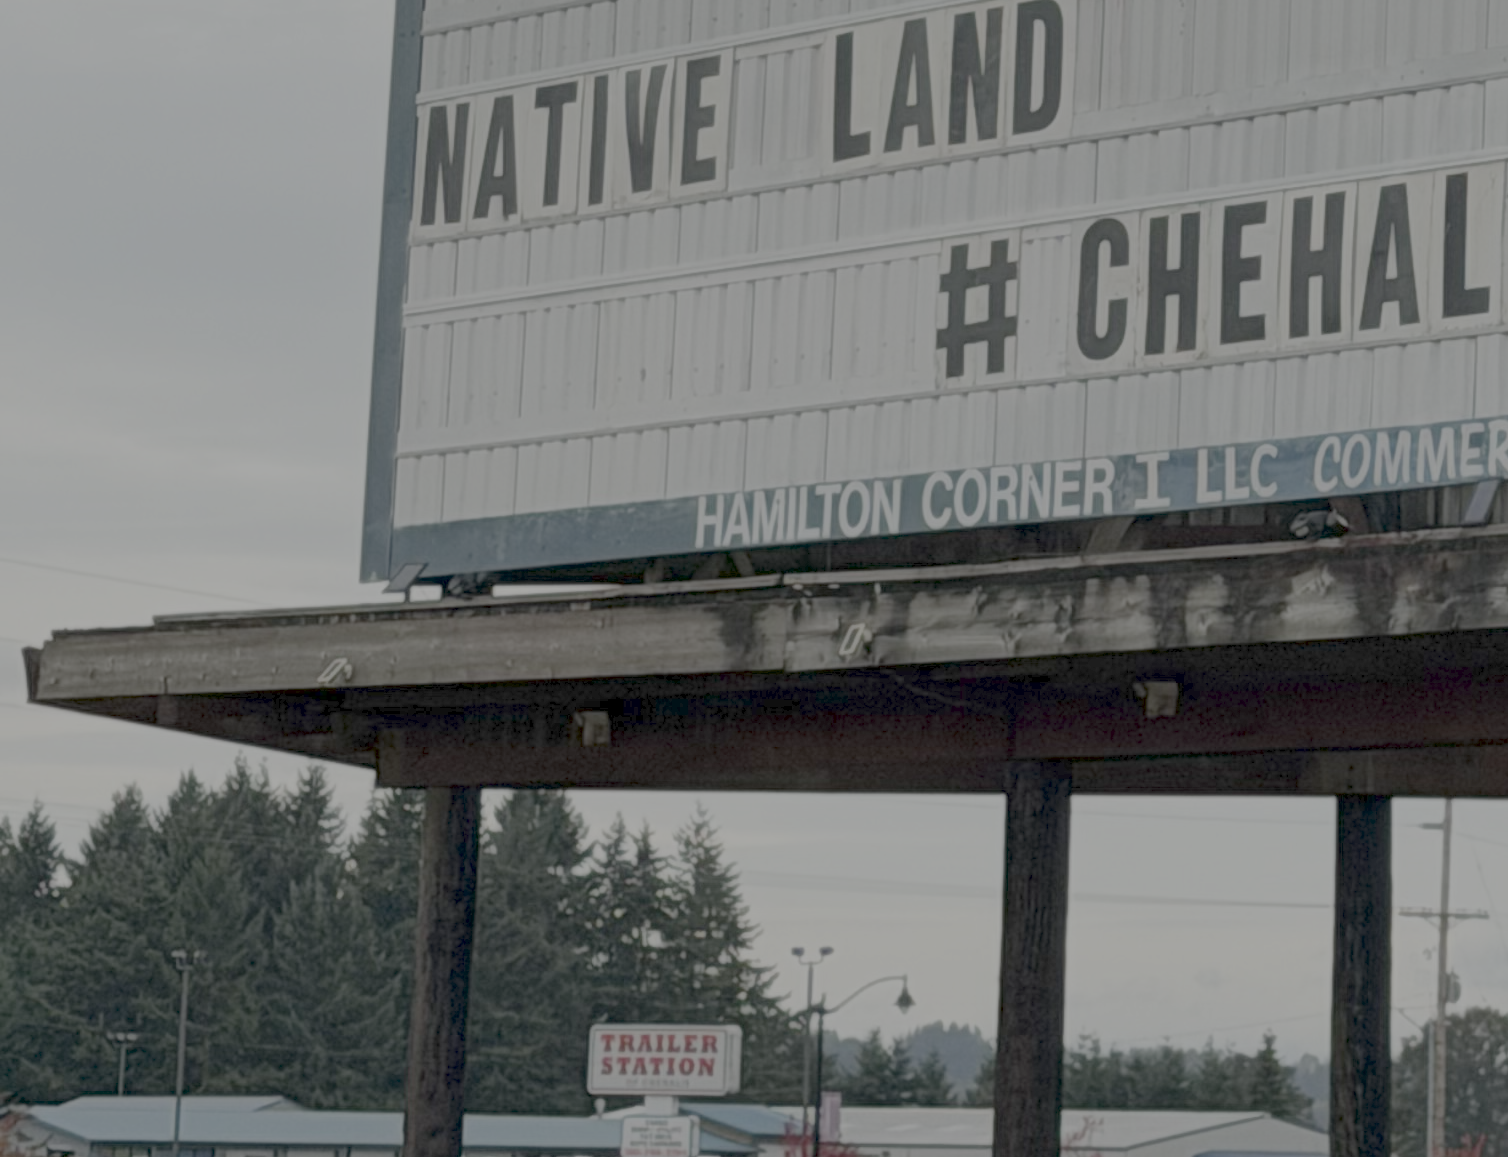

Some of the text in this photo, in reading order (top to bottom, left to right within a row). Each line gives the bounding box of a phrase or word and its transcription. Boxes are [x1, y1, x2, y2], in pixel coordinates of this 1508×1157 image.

[419, 54, 722, 227] NATIVE
[936, 239, 1018, 379] #
[695, 478, 902, 549] HAMILTON
[921, 457, 1116, 531] CORNER
[1195, 444, 1279, 504] LLC
[600, 1033, 718, 1054] TRAILER
[600, 1056, 715, 1077] STATION
